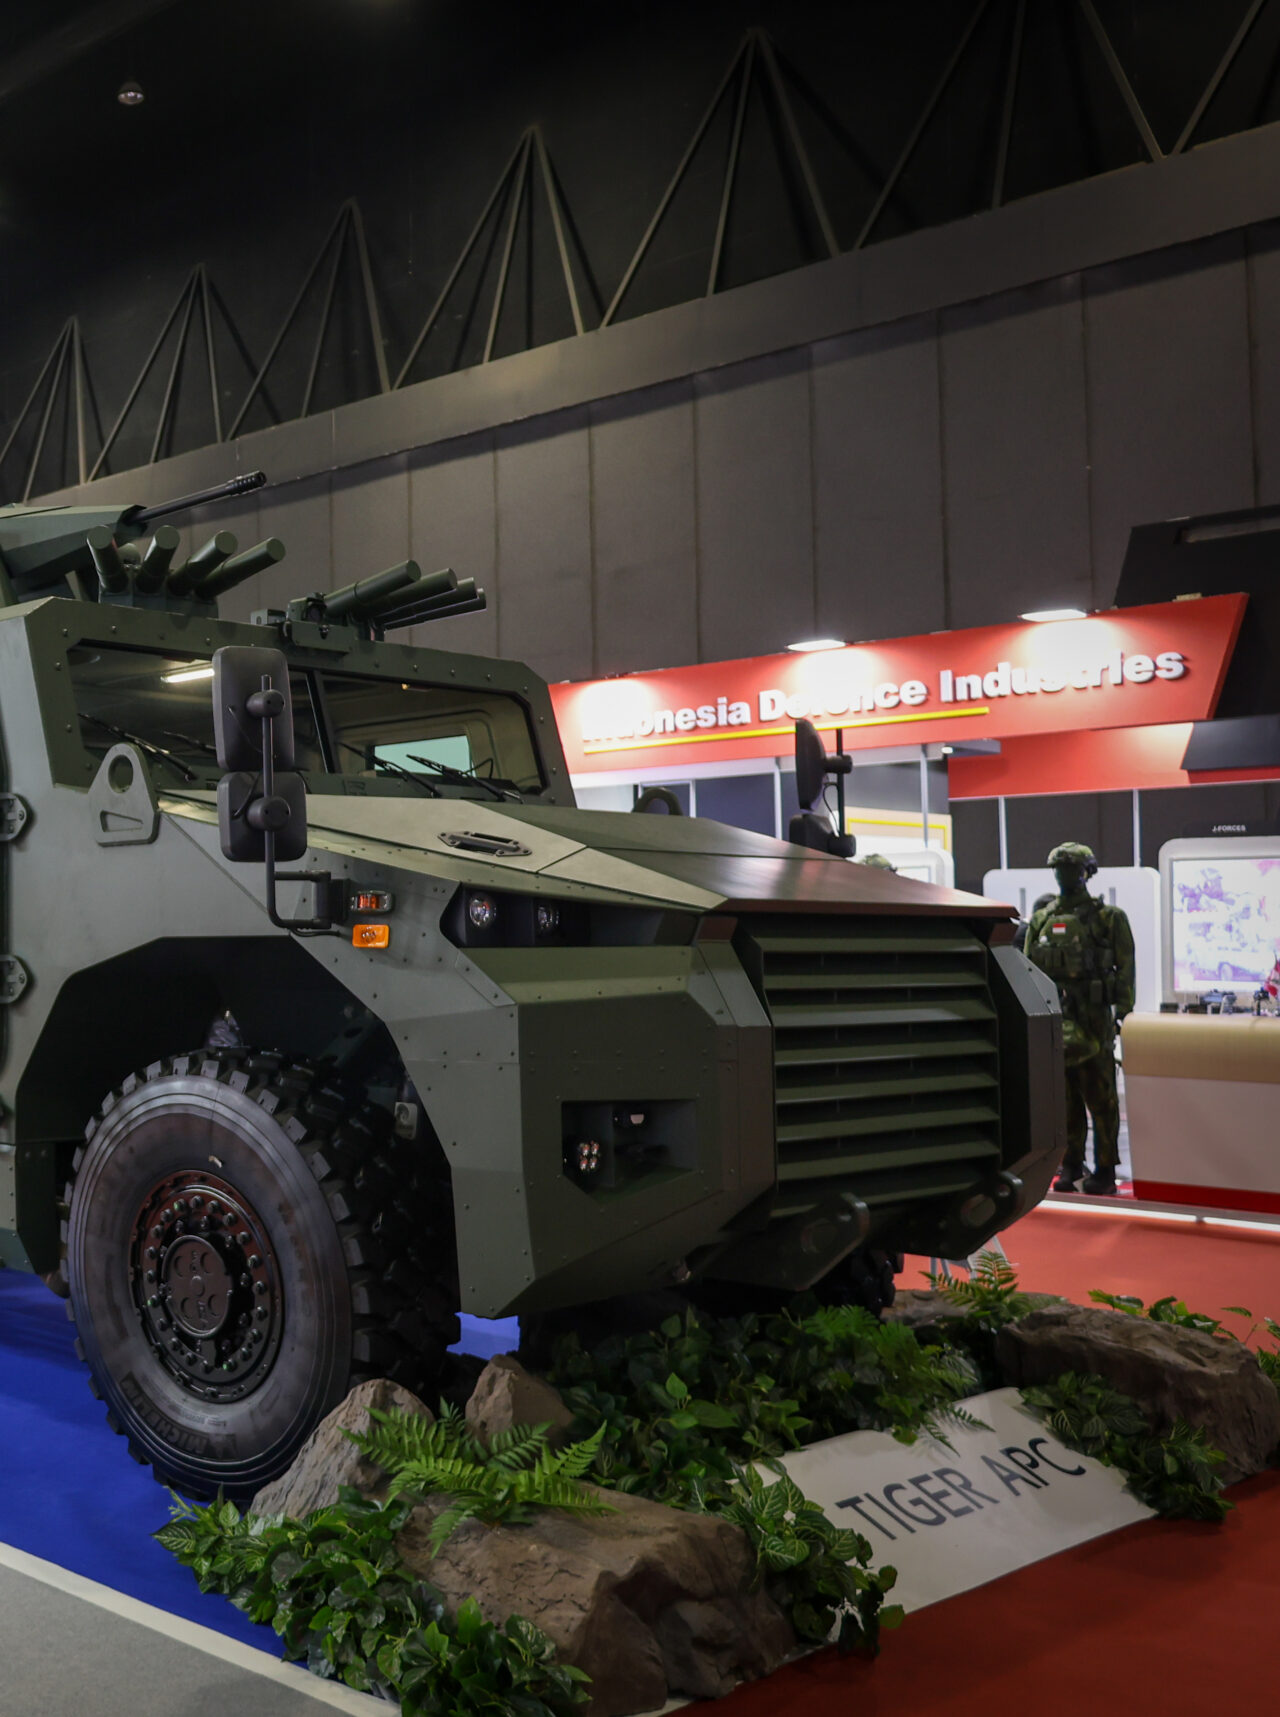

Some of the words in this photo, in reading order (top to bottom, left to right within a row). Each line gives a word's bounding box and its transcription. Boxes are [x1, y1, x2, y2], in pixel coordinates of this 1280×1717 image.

[582, 697, 752, 740] onesia
[835, 1467, 1000, 1541] TIGER
[980, 1437, 1086, 1497] APC
